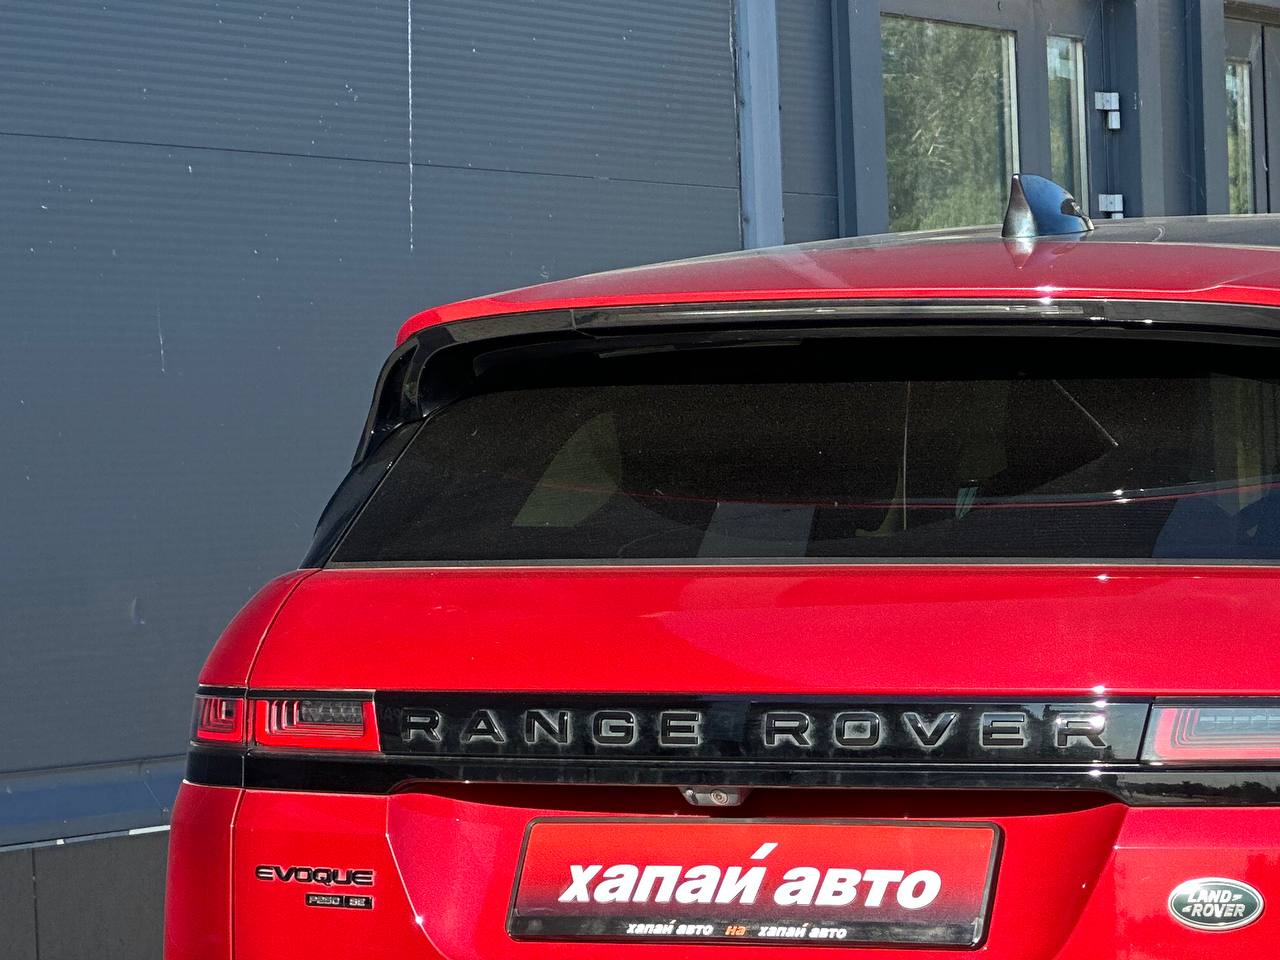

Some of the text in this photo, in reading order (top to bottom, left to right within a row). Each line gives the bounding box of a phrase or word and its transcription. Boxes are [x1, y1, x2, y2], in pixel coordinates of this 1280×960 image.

[401, 708, 1107, 748] RANGE ROVER
[255, 865, 373, 886] EVOQUE
[773, 865, 942, 909] авто
[1188, 889, 1232, 903] LAND
[1191, 903, 1246, 918] ROVER
[675, 924, 714, 936] авто
[725, 924, 746, 936] на
[808, 926, 848, 939] авто
